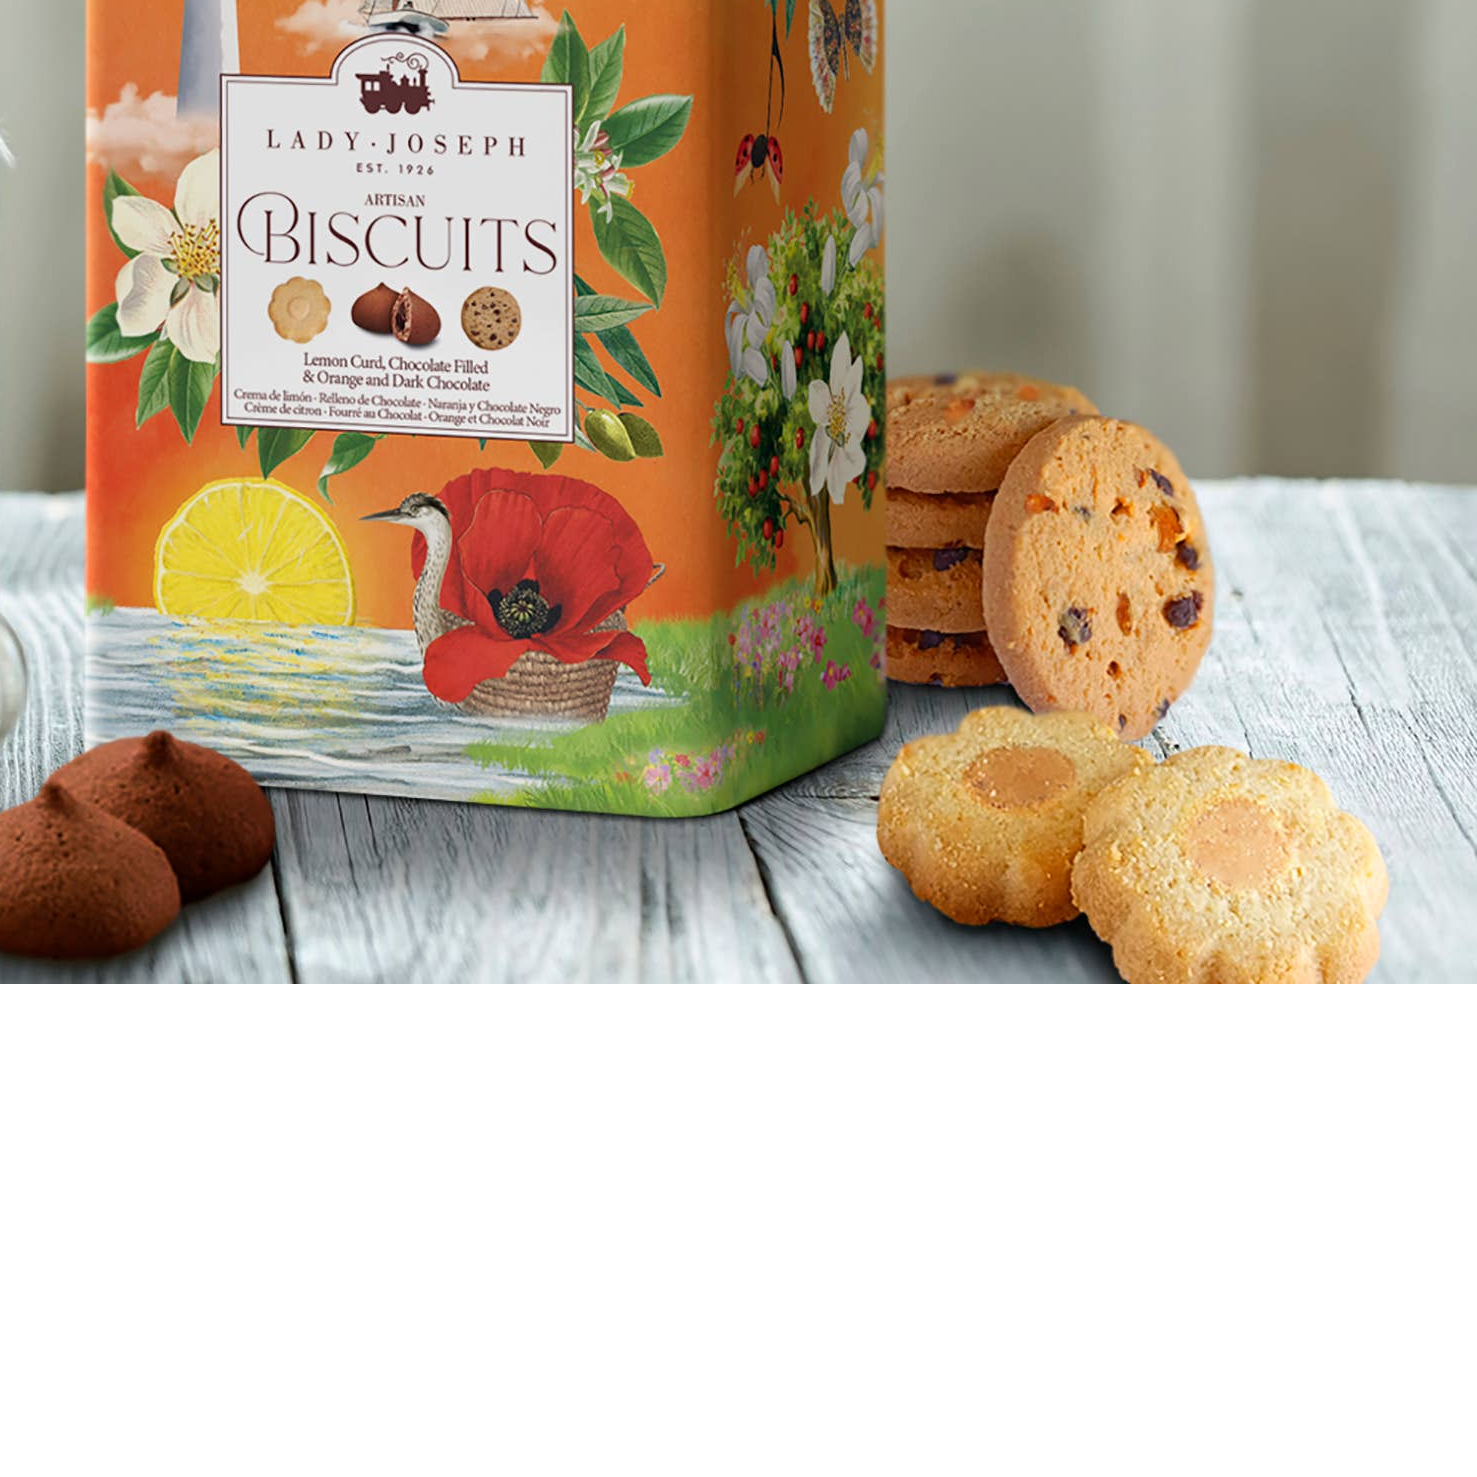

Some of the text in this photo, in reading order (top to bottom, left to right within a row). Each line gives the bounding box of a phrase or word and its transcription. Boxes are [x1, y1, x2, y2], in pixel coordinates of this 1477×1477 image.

[356, 162, 435, 176] EST. 1926
[364, 193, 426, 208] ARTISAN
[237, 191, 558, 275] BISCUITS
[303, 352, 489, 374] Lemon Curd, Chocolate Filled
[303, 369, 491, 392] & Orange and Dark Chocolate
[233, 388, 562, 418] Crema de limón Relleno de Chocolate Naranja y Chocolate Negro
[244, 401, 550, 428] Crème de citron Fourré au Chocolat Orange et Chocolat Noir
